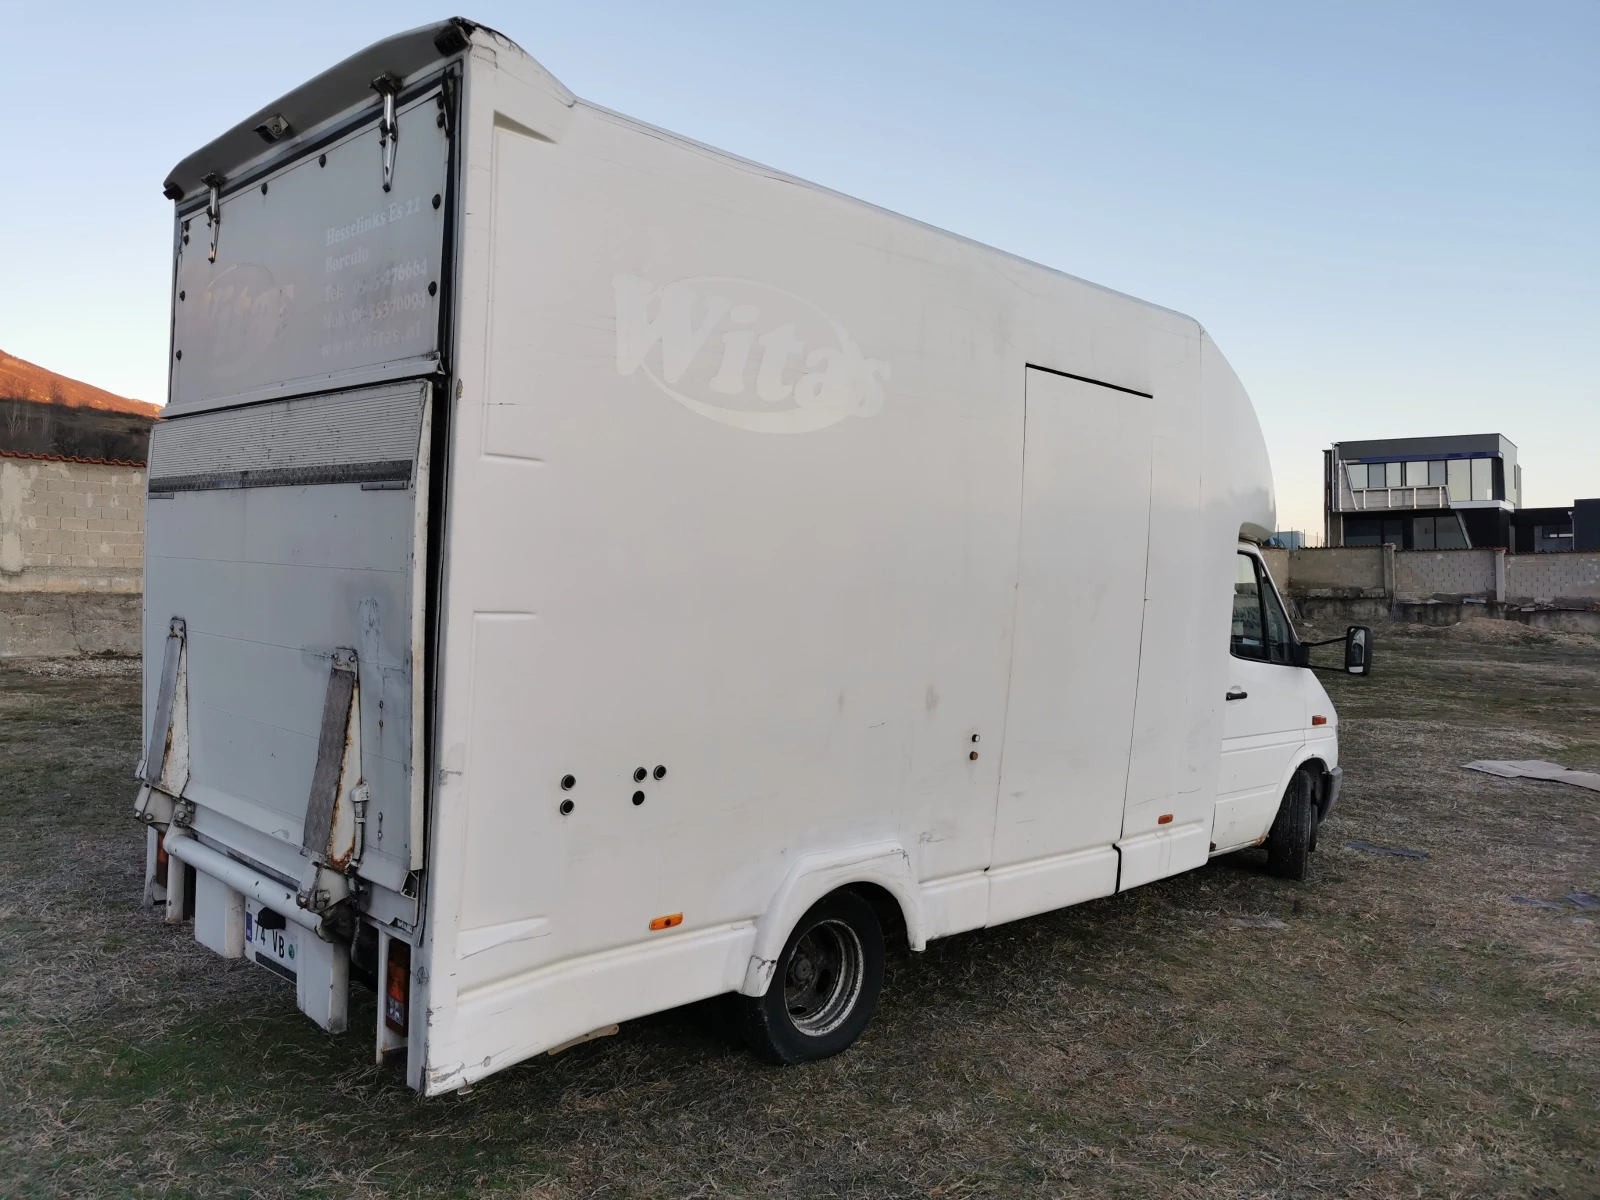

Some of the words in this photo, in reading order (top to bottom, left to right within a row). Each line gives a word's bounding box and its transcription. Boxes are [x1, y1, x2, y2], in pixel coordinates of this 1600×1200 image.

[326, 213, 385, 246] Hesselinks
[388, 202, 403, 223] Es
[406, 196, 421, 216] 22
[325, 246, 369, 273] Borculo
[610, 273, 891, 418] Witas
